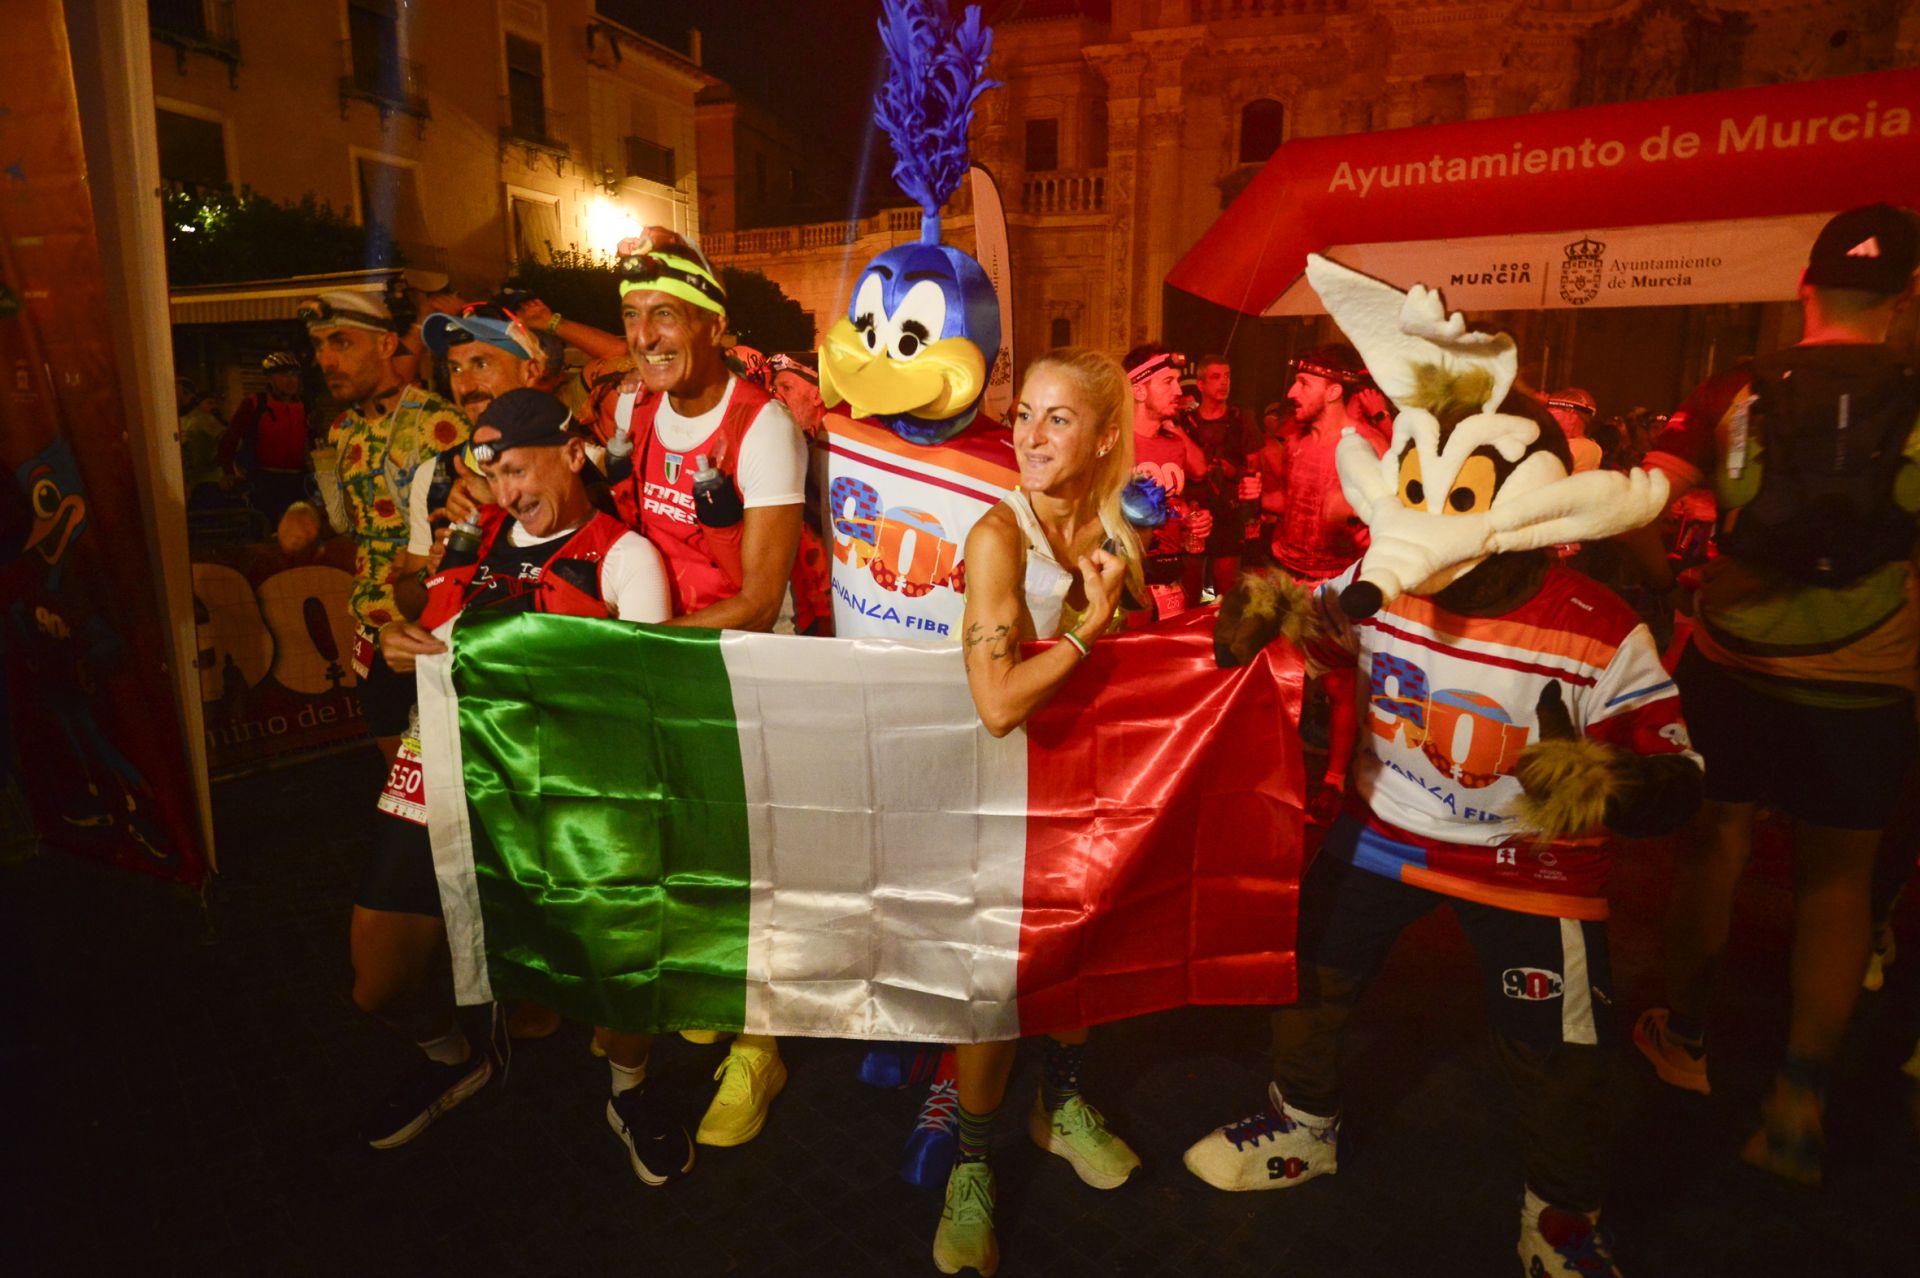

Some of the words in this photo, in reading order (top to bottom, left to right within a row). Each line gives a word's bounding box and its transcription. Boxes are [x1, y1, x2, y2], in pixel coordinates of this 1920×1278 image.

[1328, 138, 1626, 199] Ayuntamiento
[1640, 125, 1701, 163] de
[1717, 100, 1912, 156] Murcia
[1492, 263, 1531, 272] 1200
[1608, 256, 1722, 274] Ayuntamiento
[1451, 271, 1531, 286] MURCIA
[1607, 274, 1627, 289] de
[1631, 273, 1692, 288] Murcia
[831, 576, 901, 624] AVANZA
[905, 615, 950, 636] FIBR
[297, 704, 338, 729] de
[387, 763, 422, 795] 550
[1504, 969, 1562, 999] 90k
[1266, 1156, 1309, 1180] 90k
